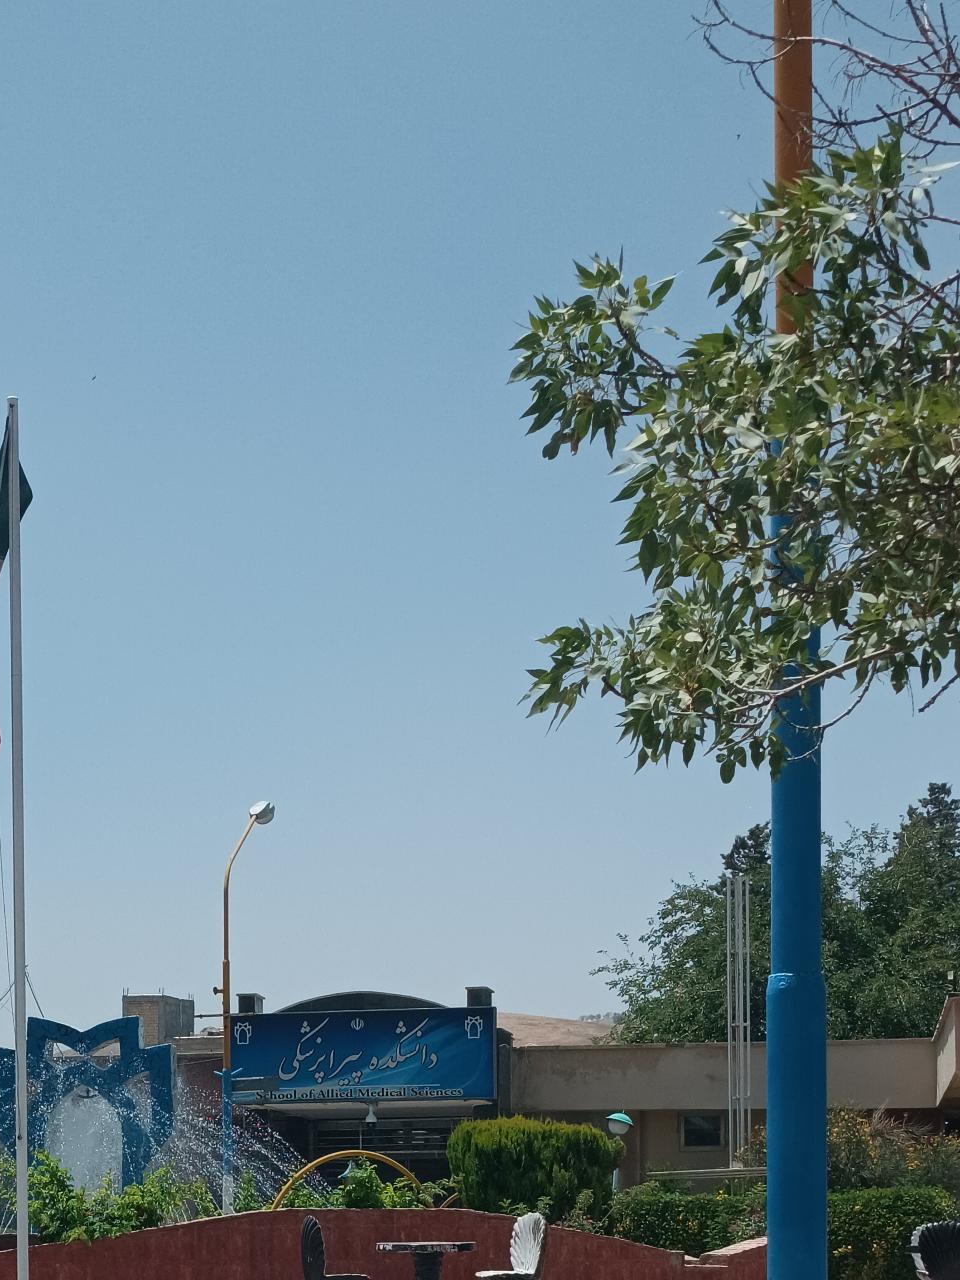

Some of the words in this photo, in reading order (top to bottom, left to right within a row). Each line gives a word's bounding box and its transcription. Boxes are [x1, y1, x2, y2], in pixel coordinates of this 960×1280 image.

[369, 1017, 438, 1069] دانشکده
[255, 1090, 297, 1100] School
[301, 1089, 317, 1099] of
[317, 1088, 353, 1099] Allied
[357, 1087, 406, 1098] Medical
[410, 1086, 464, 1098] Sciences
